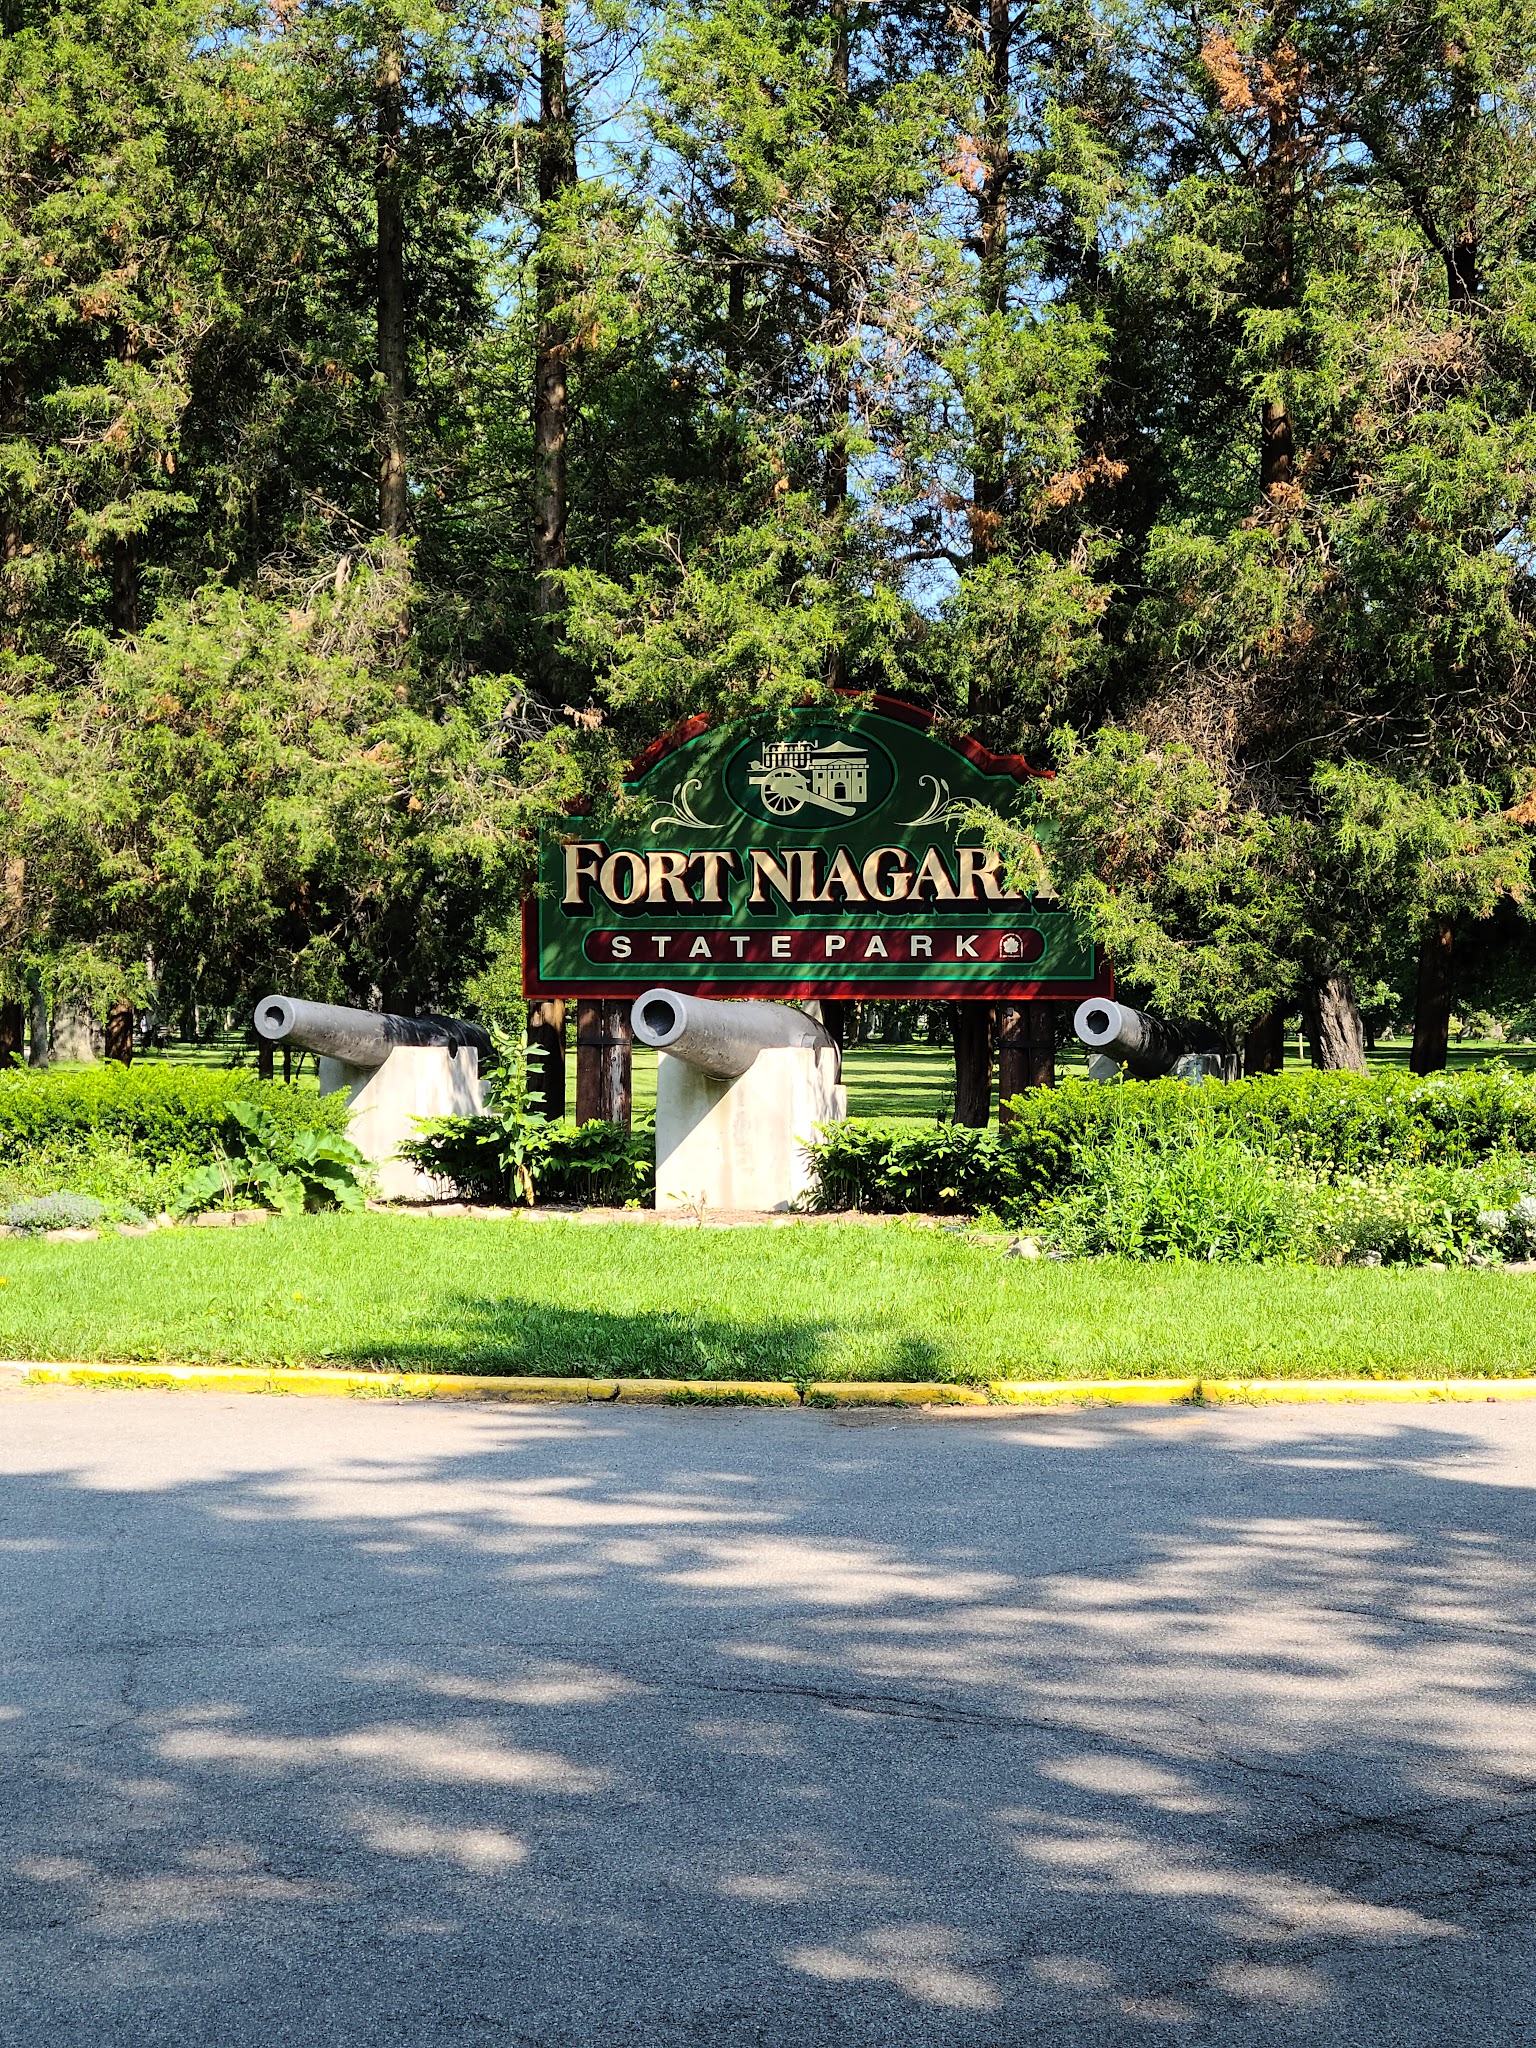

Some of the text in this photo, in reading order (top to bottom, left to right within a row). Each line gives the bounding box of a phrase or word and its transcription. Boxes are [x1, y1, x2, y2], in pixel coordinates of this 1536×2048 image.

[562, 843, 735, 904] FORT
[611, 934, 979, 958] STATE PARK
